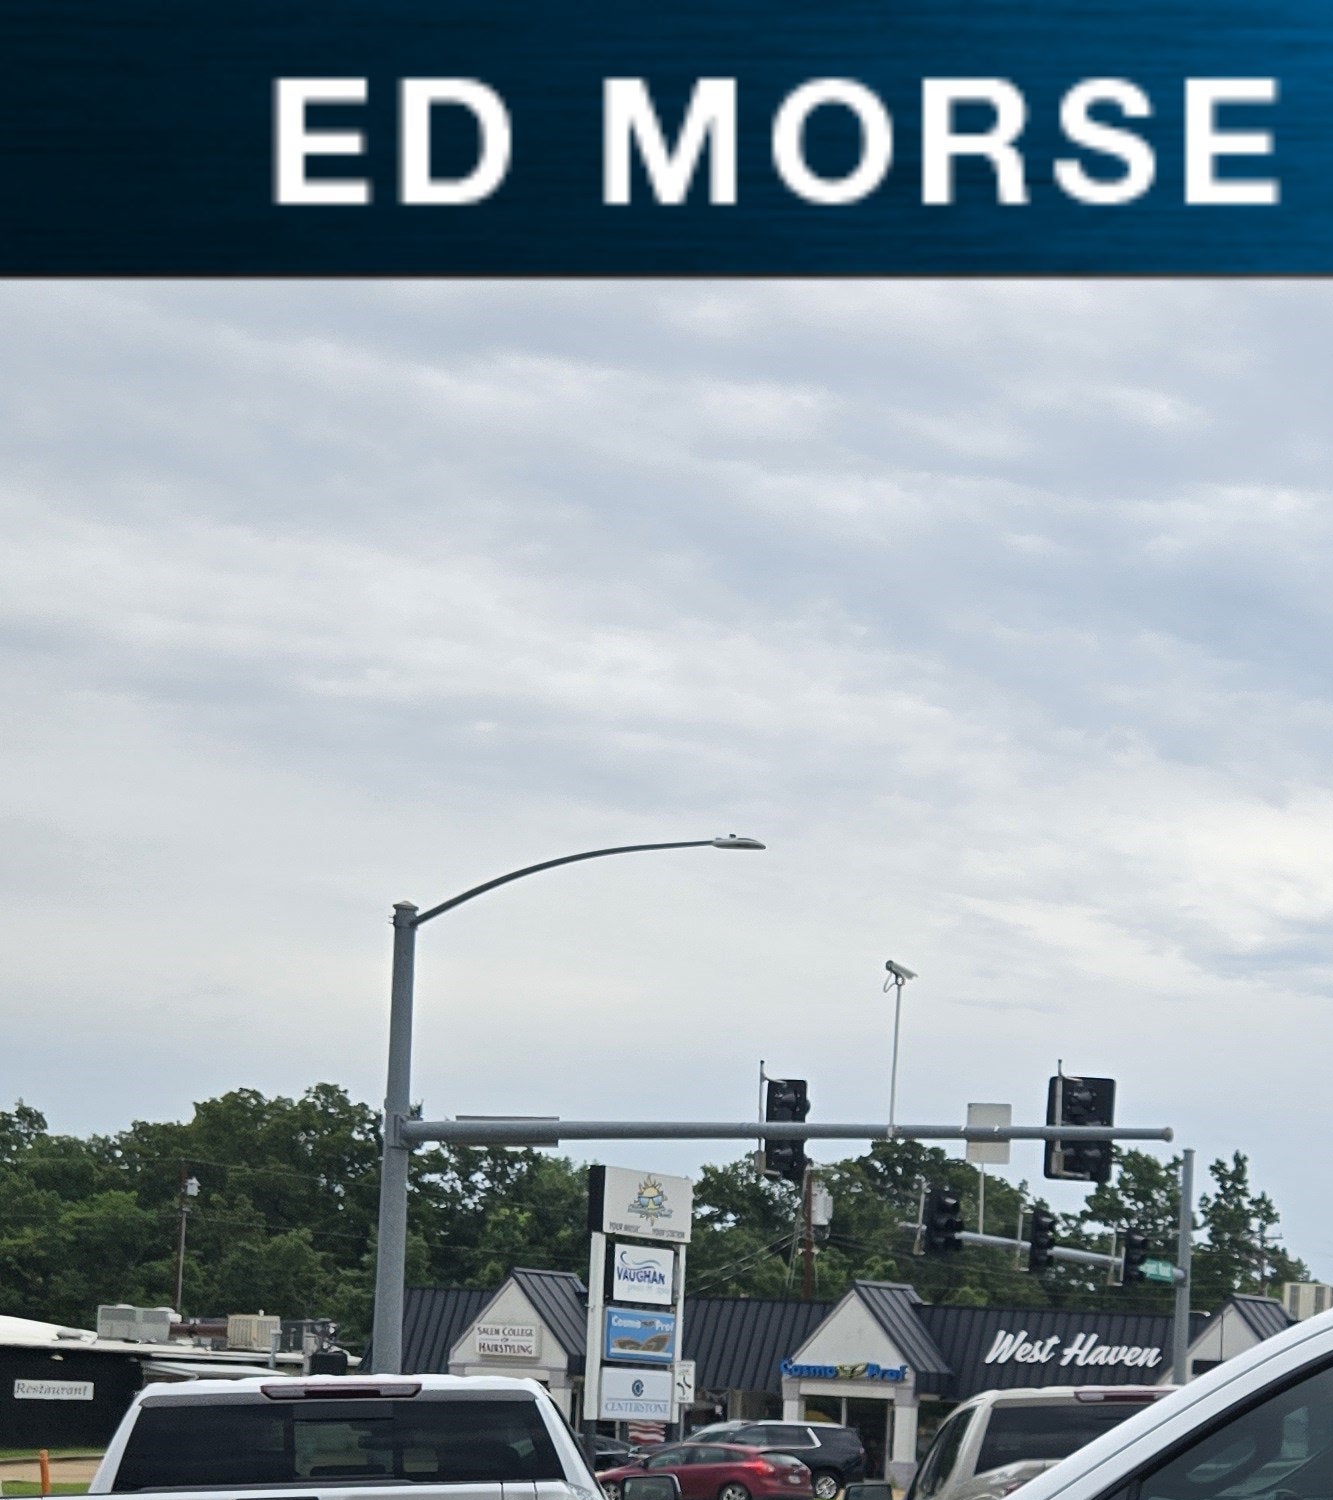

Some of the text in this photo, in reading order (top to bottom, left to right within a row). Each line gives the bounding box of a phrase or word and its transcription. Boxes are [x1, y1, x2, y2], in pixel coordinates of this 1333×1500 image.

[616, 1266, 666, 1285] VAUGHAN
[984, 1329, 1162, 1368] West Haven
[780, 1359, 908, 1382] Cosmo Prof
[16, 1382, 88, 1397] Restaurant
[604, 1401, 669, 1414] CENTERSTONE
